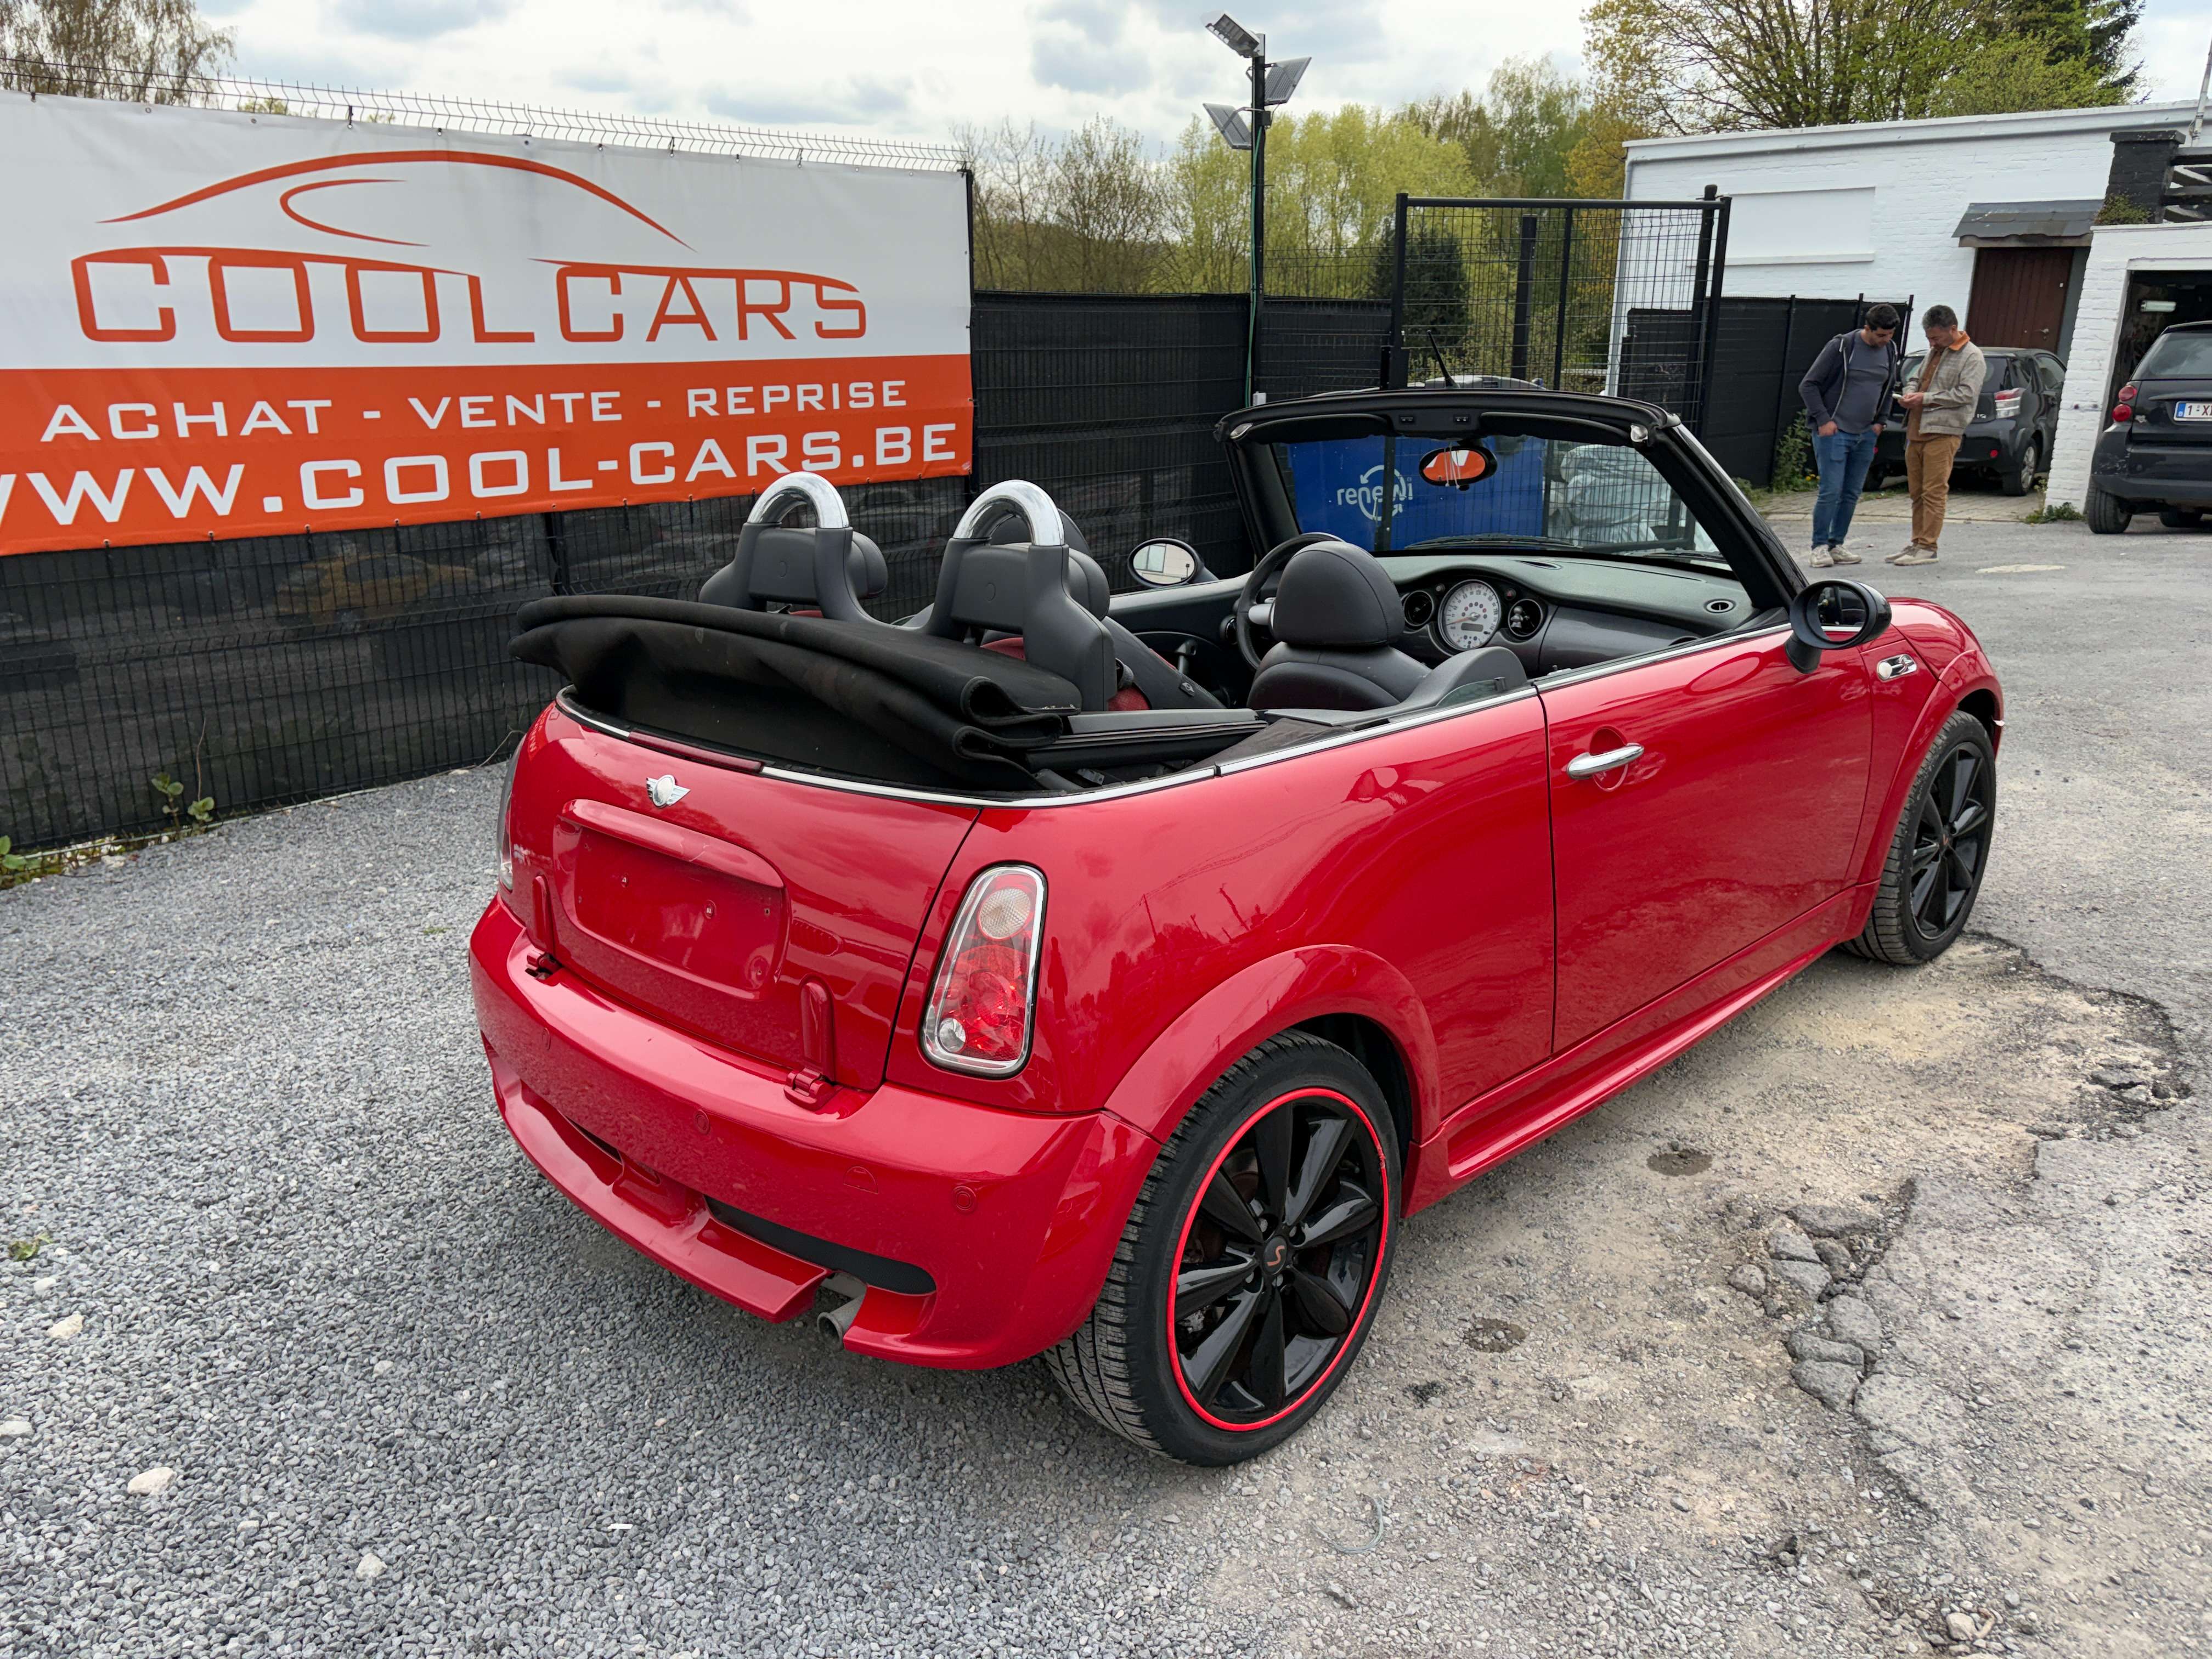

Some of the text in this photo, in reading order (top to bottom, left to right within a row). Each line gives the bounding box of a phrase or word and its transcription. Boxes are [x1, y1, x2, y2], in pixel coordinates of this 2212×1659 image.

[72, 247, 866, 343] COOL CARS
[41, 400, 331, 441] ACHAT
[408, 392, 622, 429] VENTE
[687, 380, 907, 417] REPRISE
[0, 423, 956, 526] WW.COOL-CARS.BE
